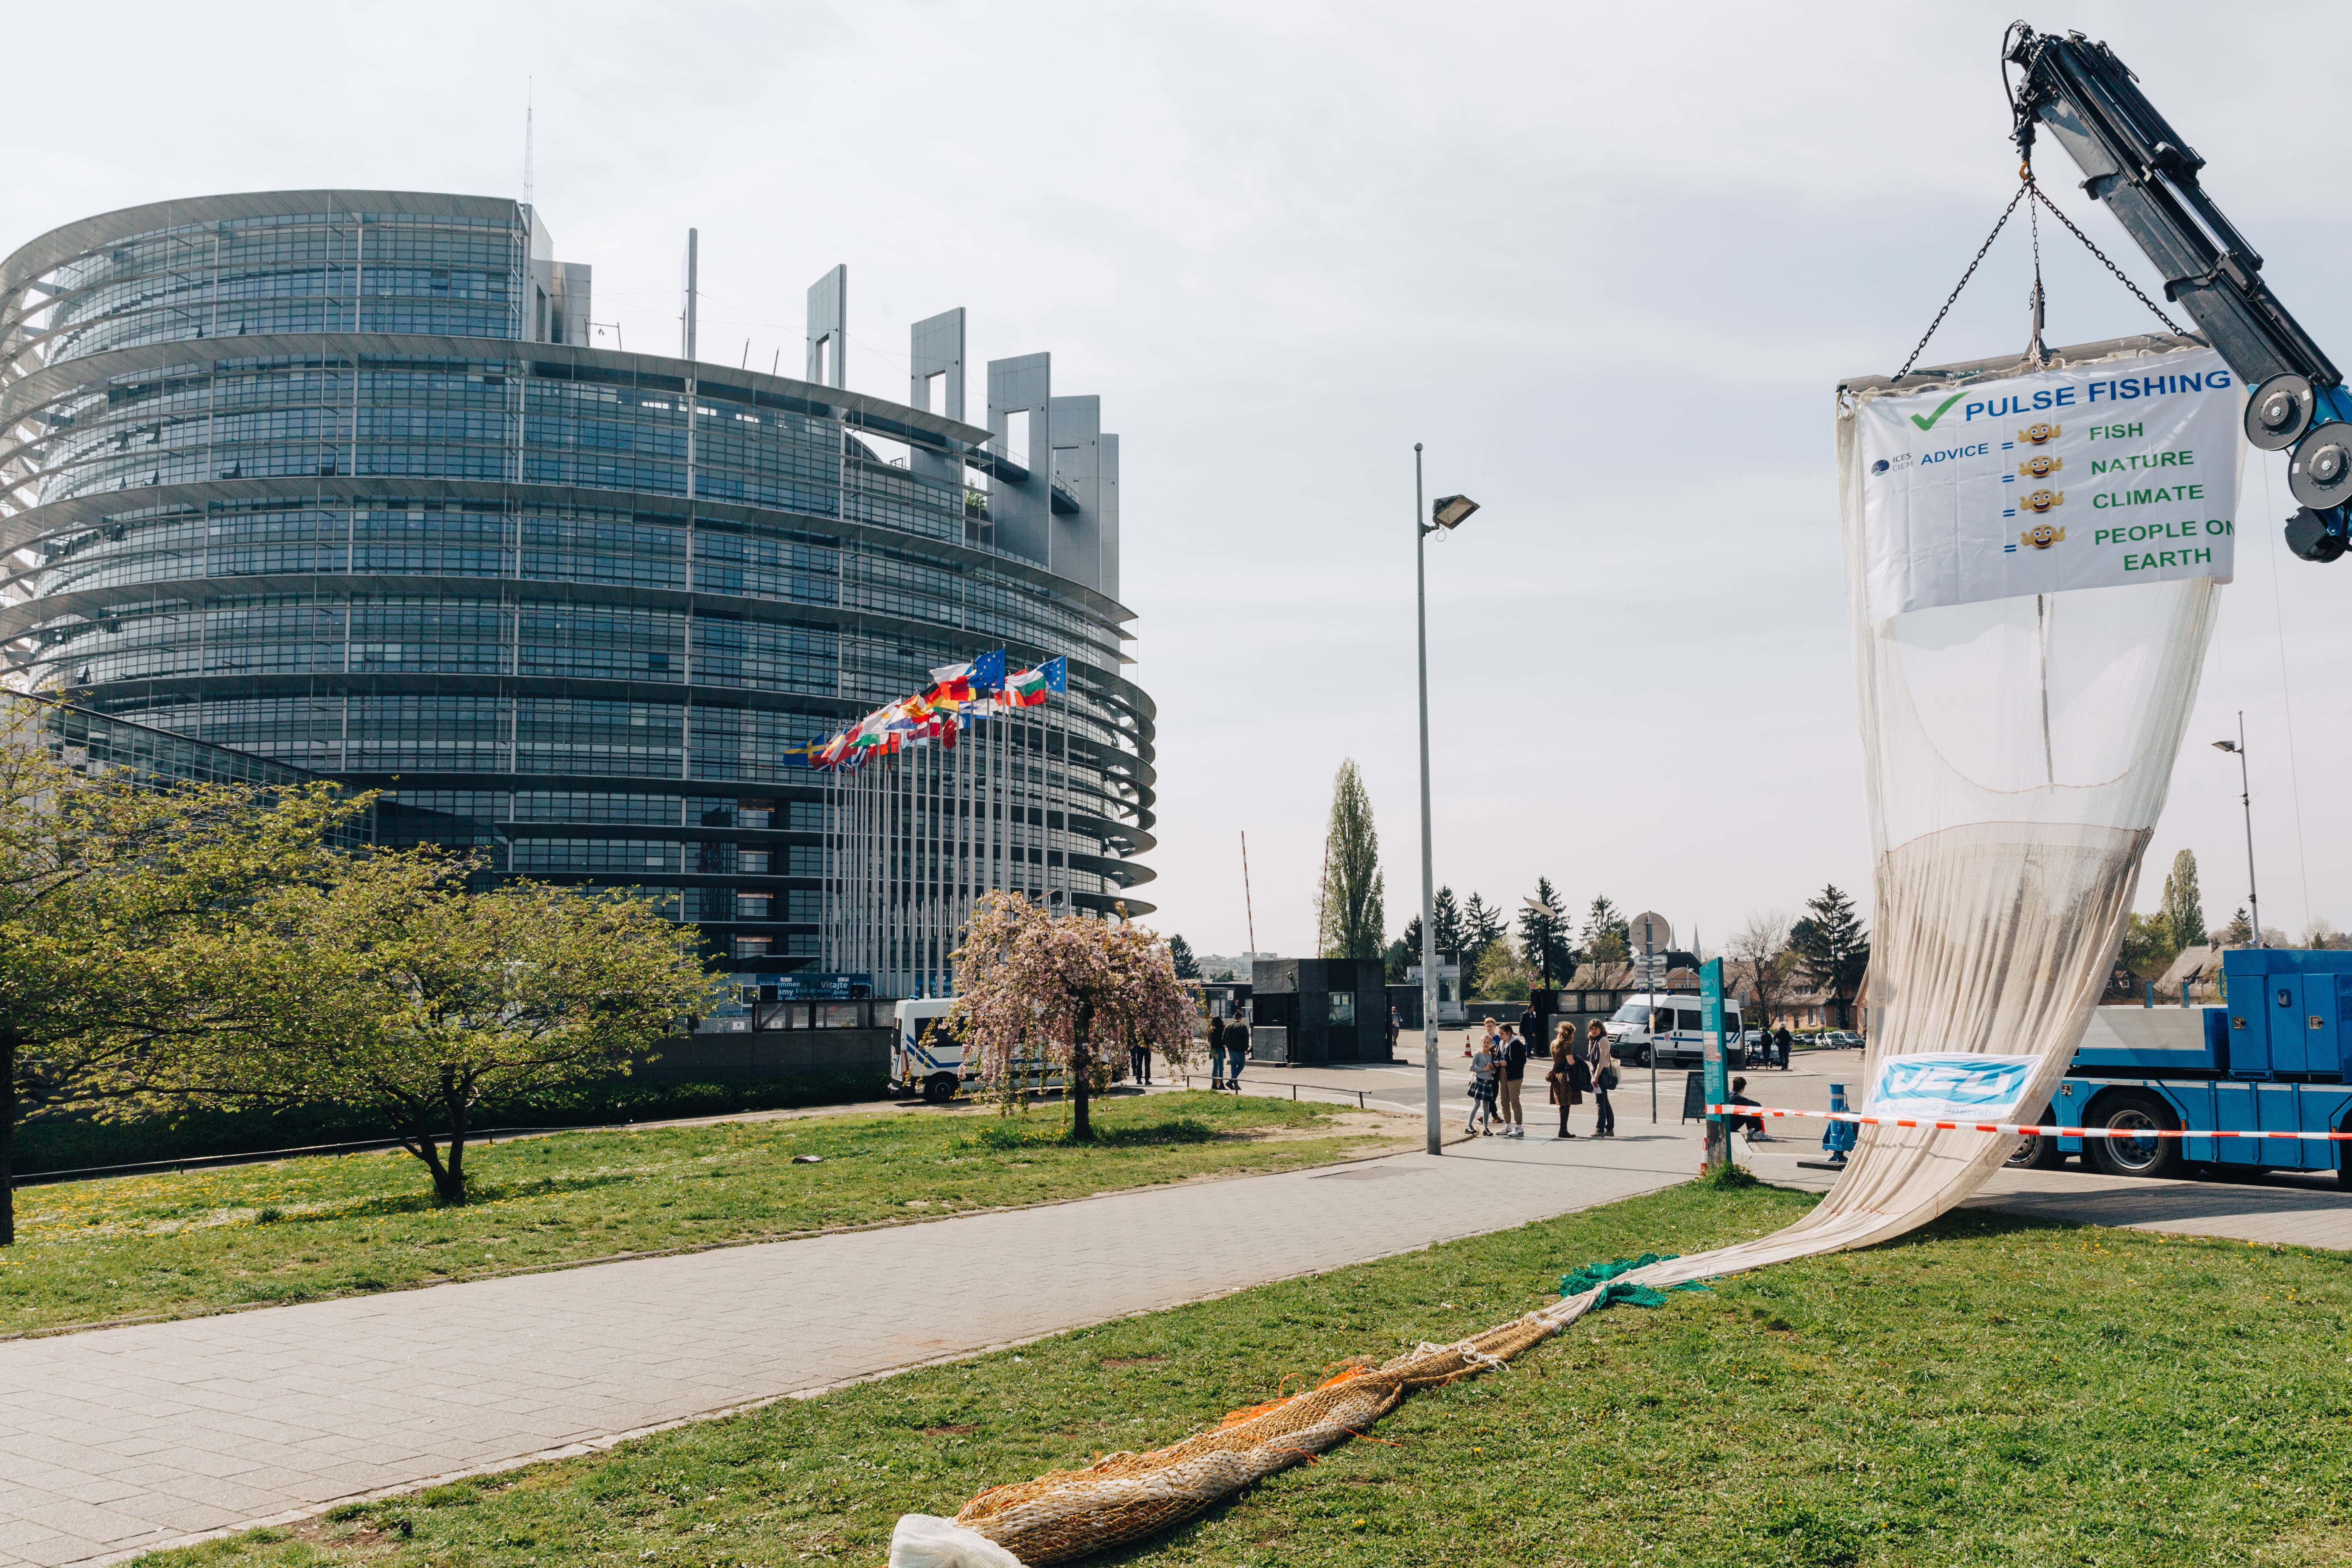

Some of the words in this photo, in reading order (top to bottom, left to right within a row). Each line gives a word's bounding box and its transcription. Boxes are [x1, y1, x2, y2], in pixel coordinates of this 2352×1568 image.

[1966, 386, 2076, 421] PULSE
[2089, 370, 2231, 402] FISHING
[1921, 443, 1989, 466] ADVICE
[2090, 422, 2143, 441] FISH
[1893, 452, 1911, 463] ICES
[1893, 461, 1913, 471] CIEM
[2091, 450, 2194, 475] NATURE
[2093, 484, 2204, 509] CLIMATE
[2095, 521, 2197, 545] PEOPLE
[2124, 548, 2211, 571] EARTH
[821, 981, 848, 990] Vitajte
[1944, 1105, 2003, 1117] Specialist
